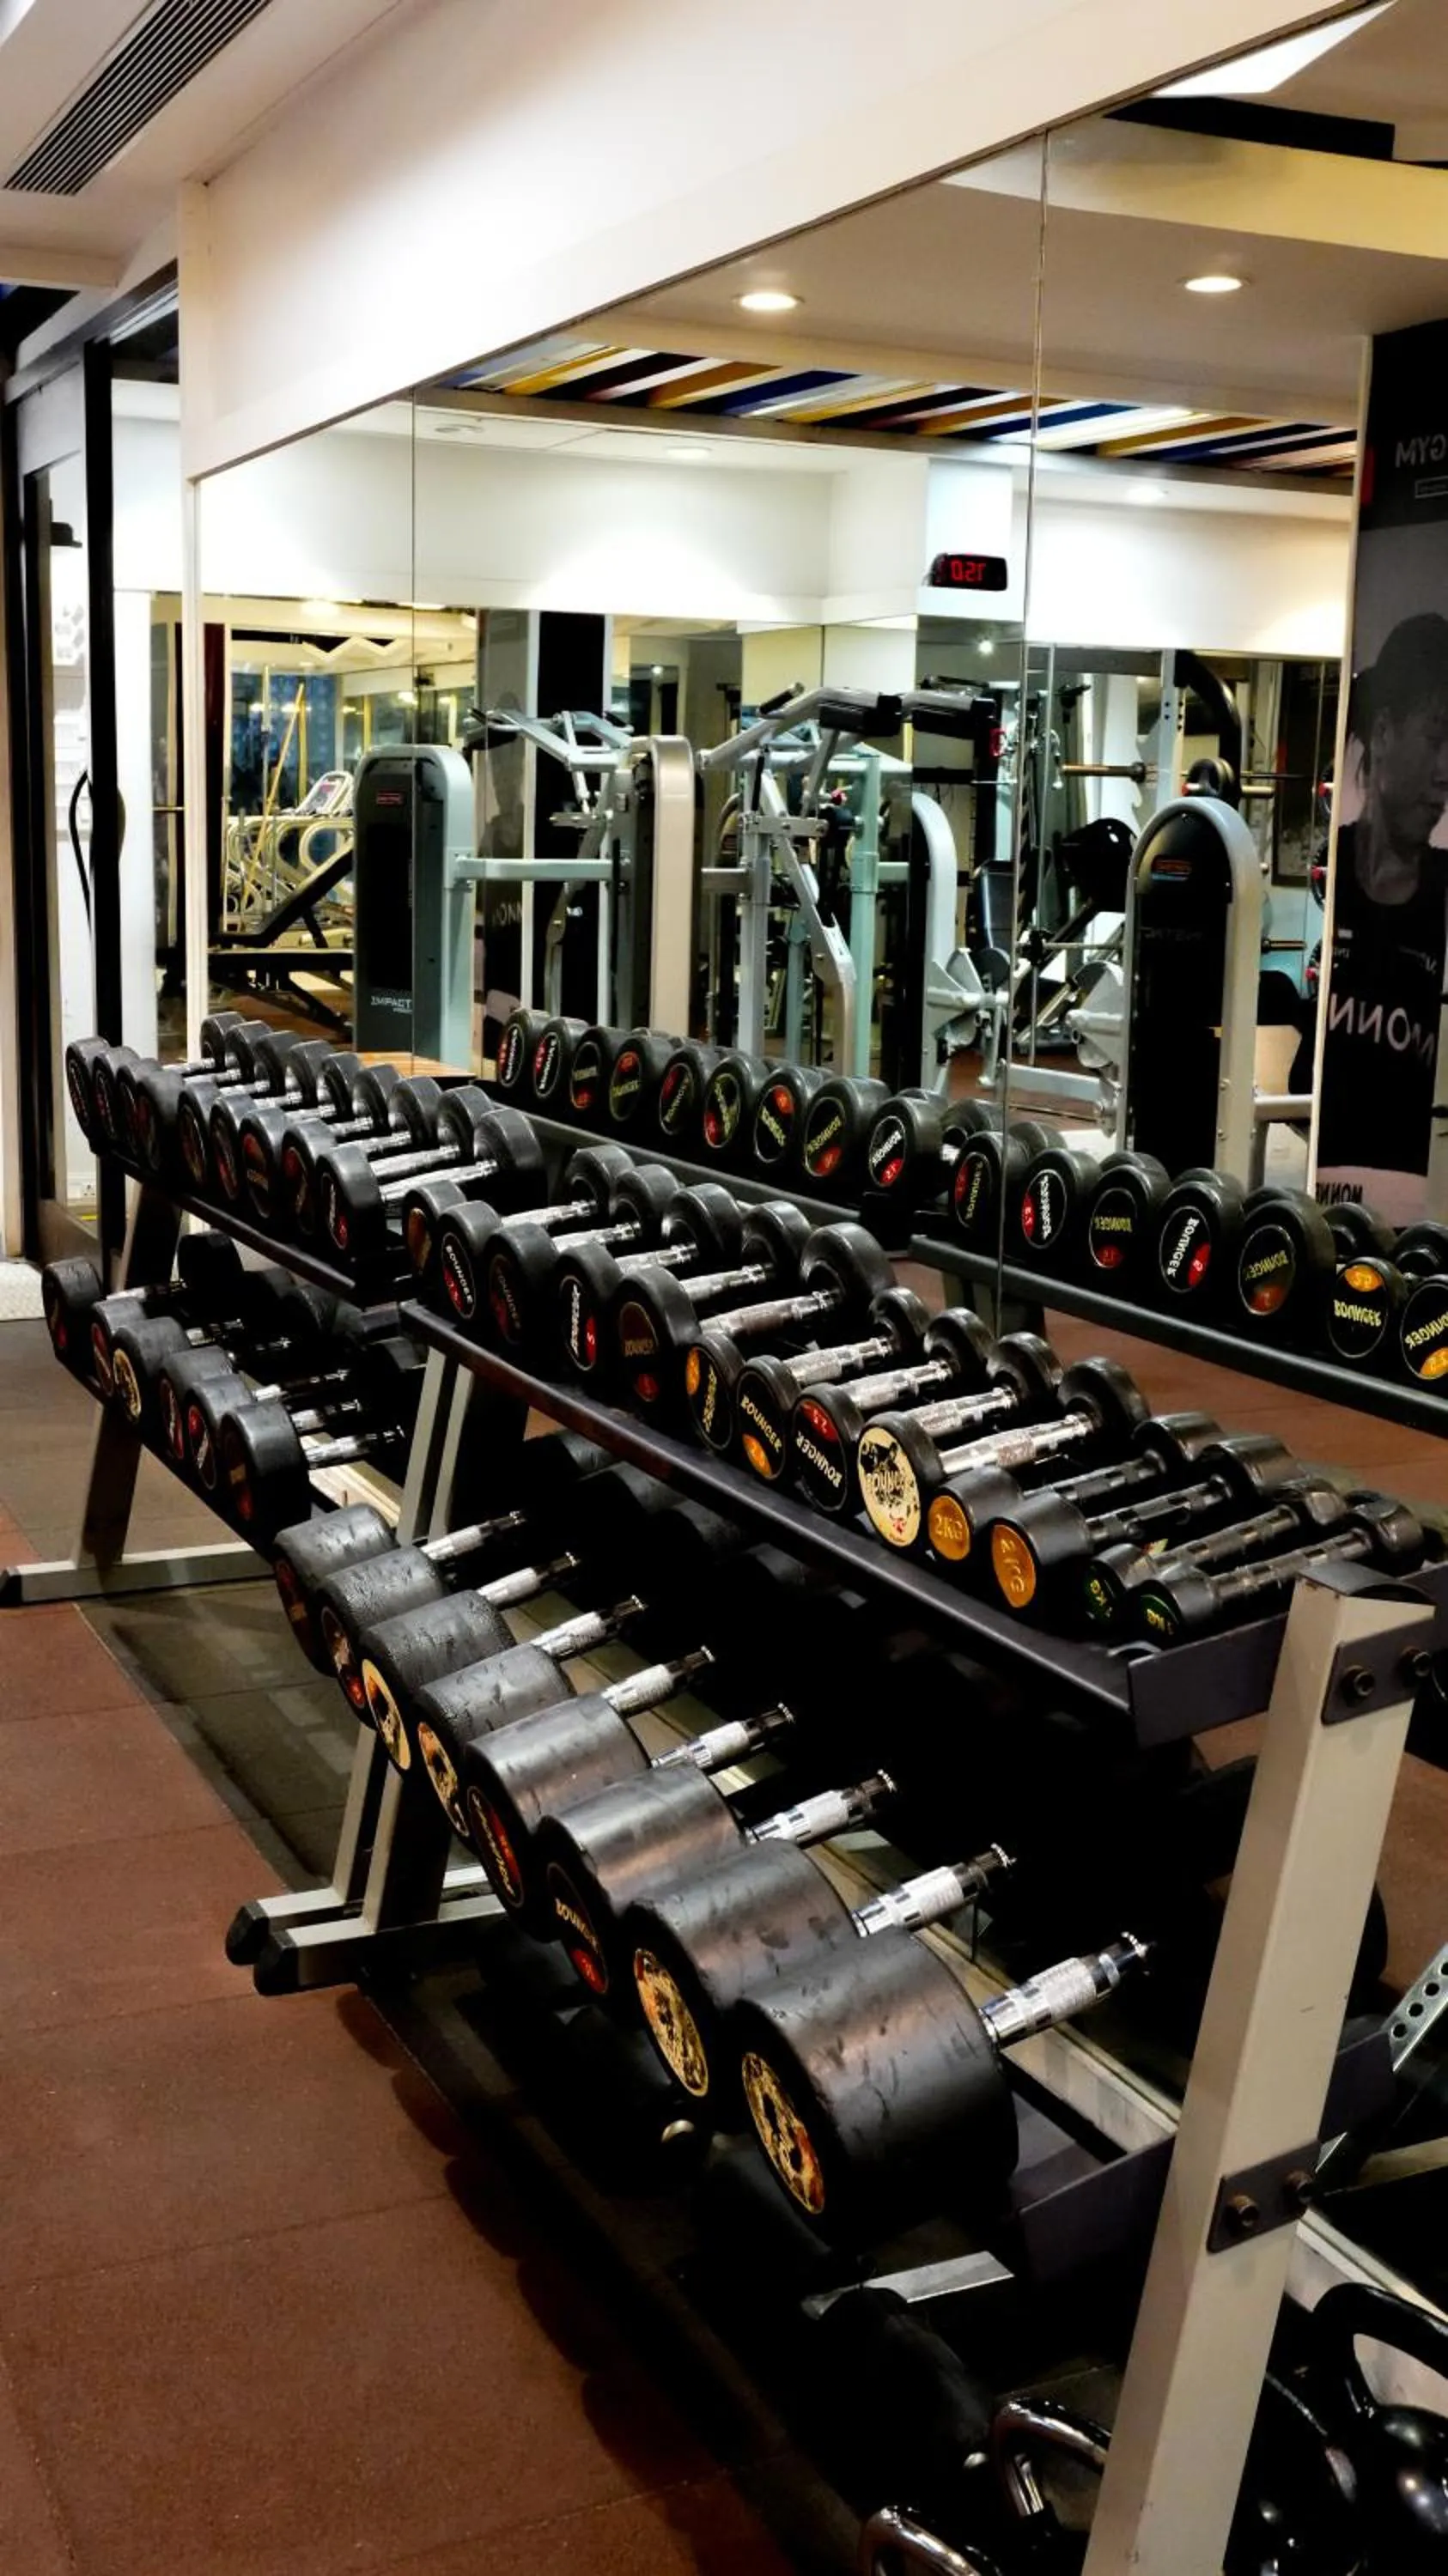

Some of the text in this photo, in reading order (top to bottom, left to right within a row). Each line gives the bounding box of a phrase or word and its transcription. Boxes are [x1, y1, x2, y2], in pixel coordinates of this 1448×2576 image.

[370, 995, 412, 1009] IMPACT
[740, 1394, 782, 1453] BOUNCER
[795, 1430, 843, 1489] BOUNCER
[934, 1513, 964, 1540] 2KG
